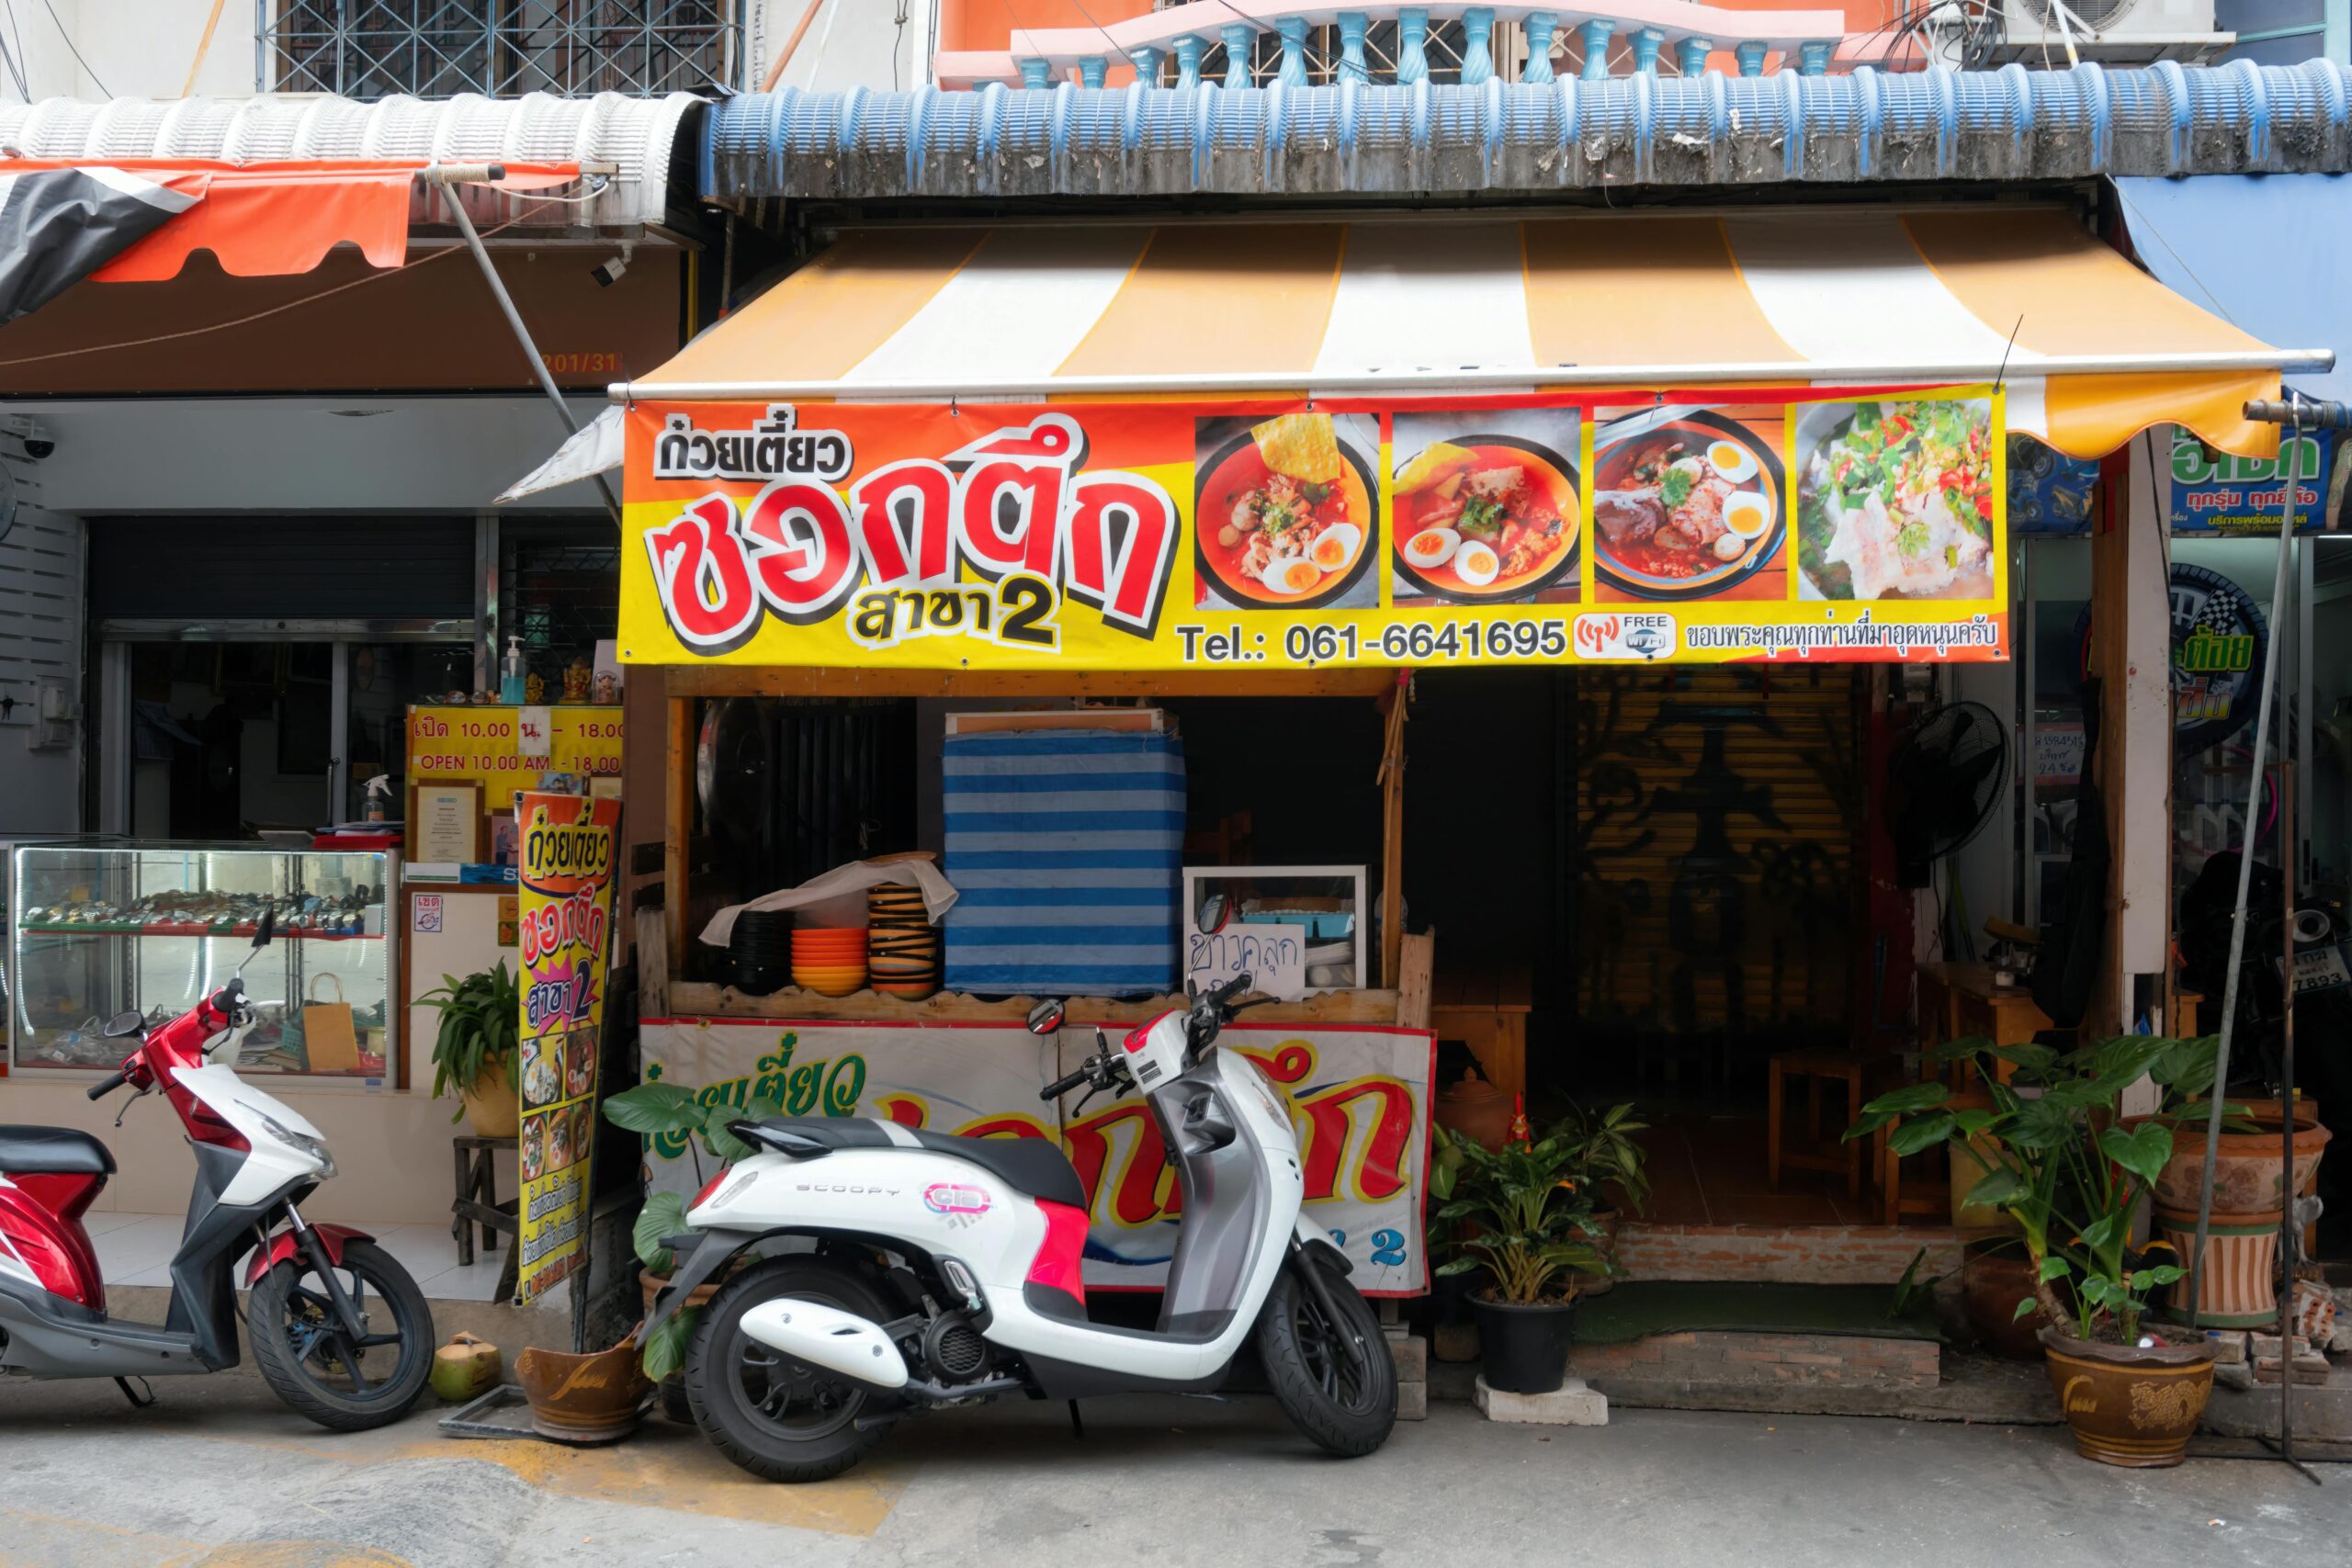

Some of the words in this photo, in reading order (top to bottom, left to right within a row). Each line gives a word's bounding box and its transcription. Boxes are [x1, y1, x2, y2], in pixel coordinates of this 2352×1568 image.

[542, 353, 616, 372] 201/31
[660, 408, 845, 474] ก๋วยเตี๋ยว
[2188, 488, 2242, 510] ทุกรุ่น
[1624, 616, 1668, 627] FREE
[1687, 610, 1996, 656] ขอบพระคุณทุกท่านที่มาอุดหนุนครับ
[1176, 626, 1265, 660] Tel.:
[1285, 620, 1566, 660] 061-6641695
[413, 715, 449, 738] เปิด
[460, 722, 511, 738] 10.00
[420, 755, 466, 770] OPEN
[472, 755, 519, 771] 10.00
[523, 755, 557, 771] AM.
[572, 756, 619, 772] 18.00
[528, 802, 610, 871] ก๋วยเตี๋ยว
[796, 1183, 901, 1197] SCOOPY
[1370, 1228, 1407, 1267] 2
